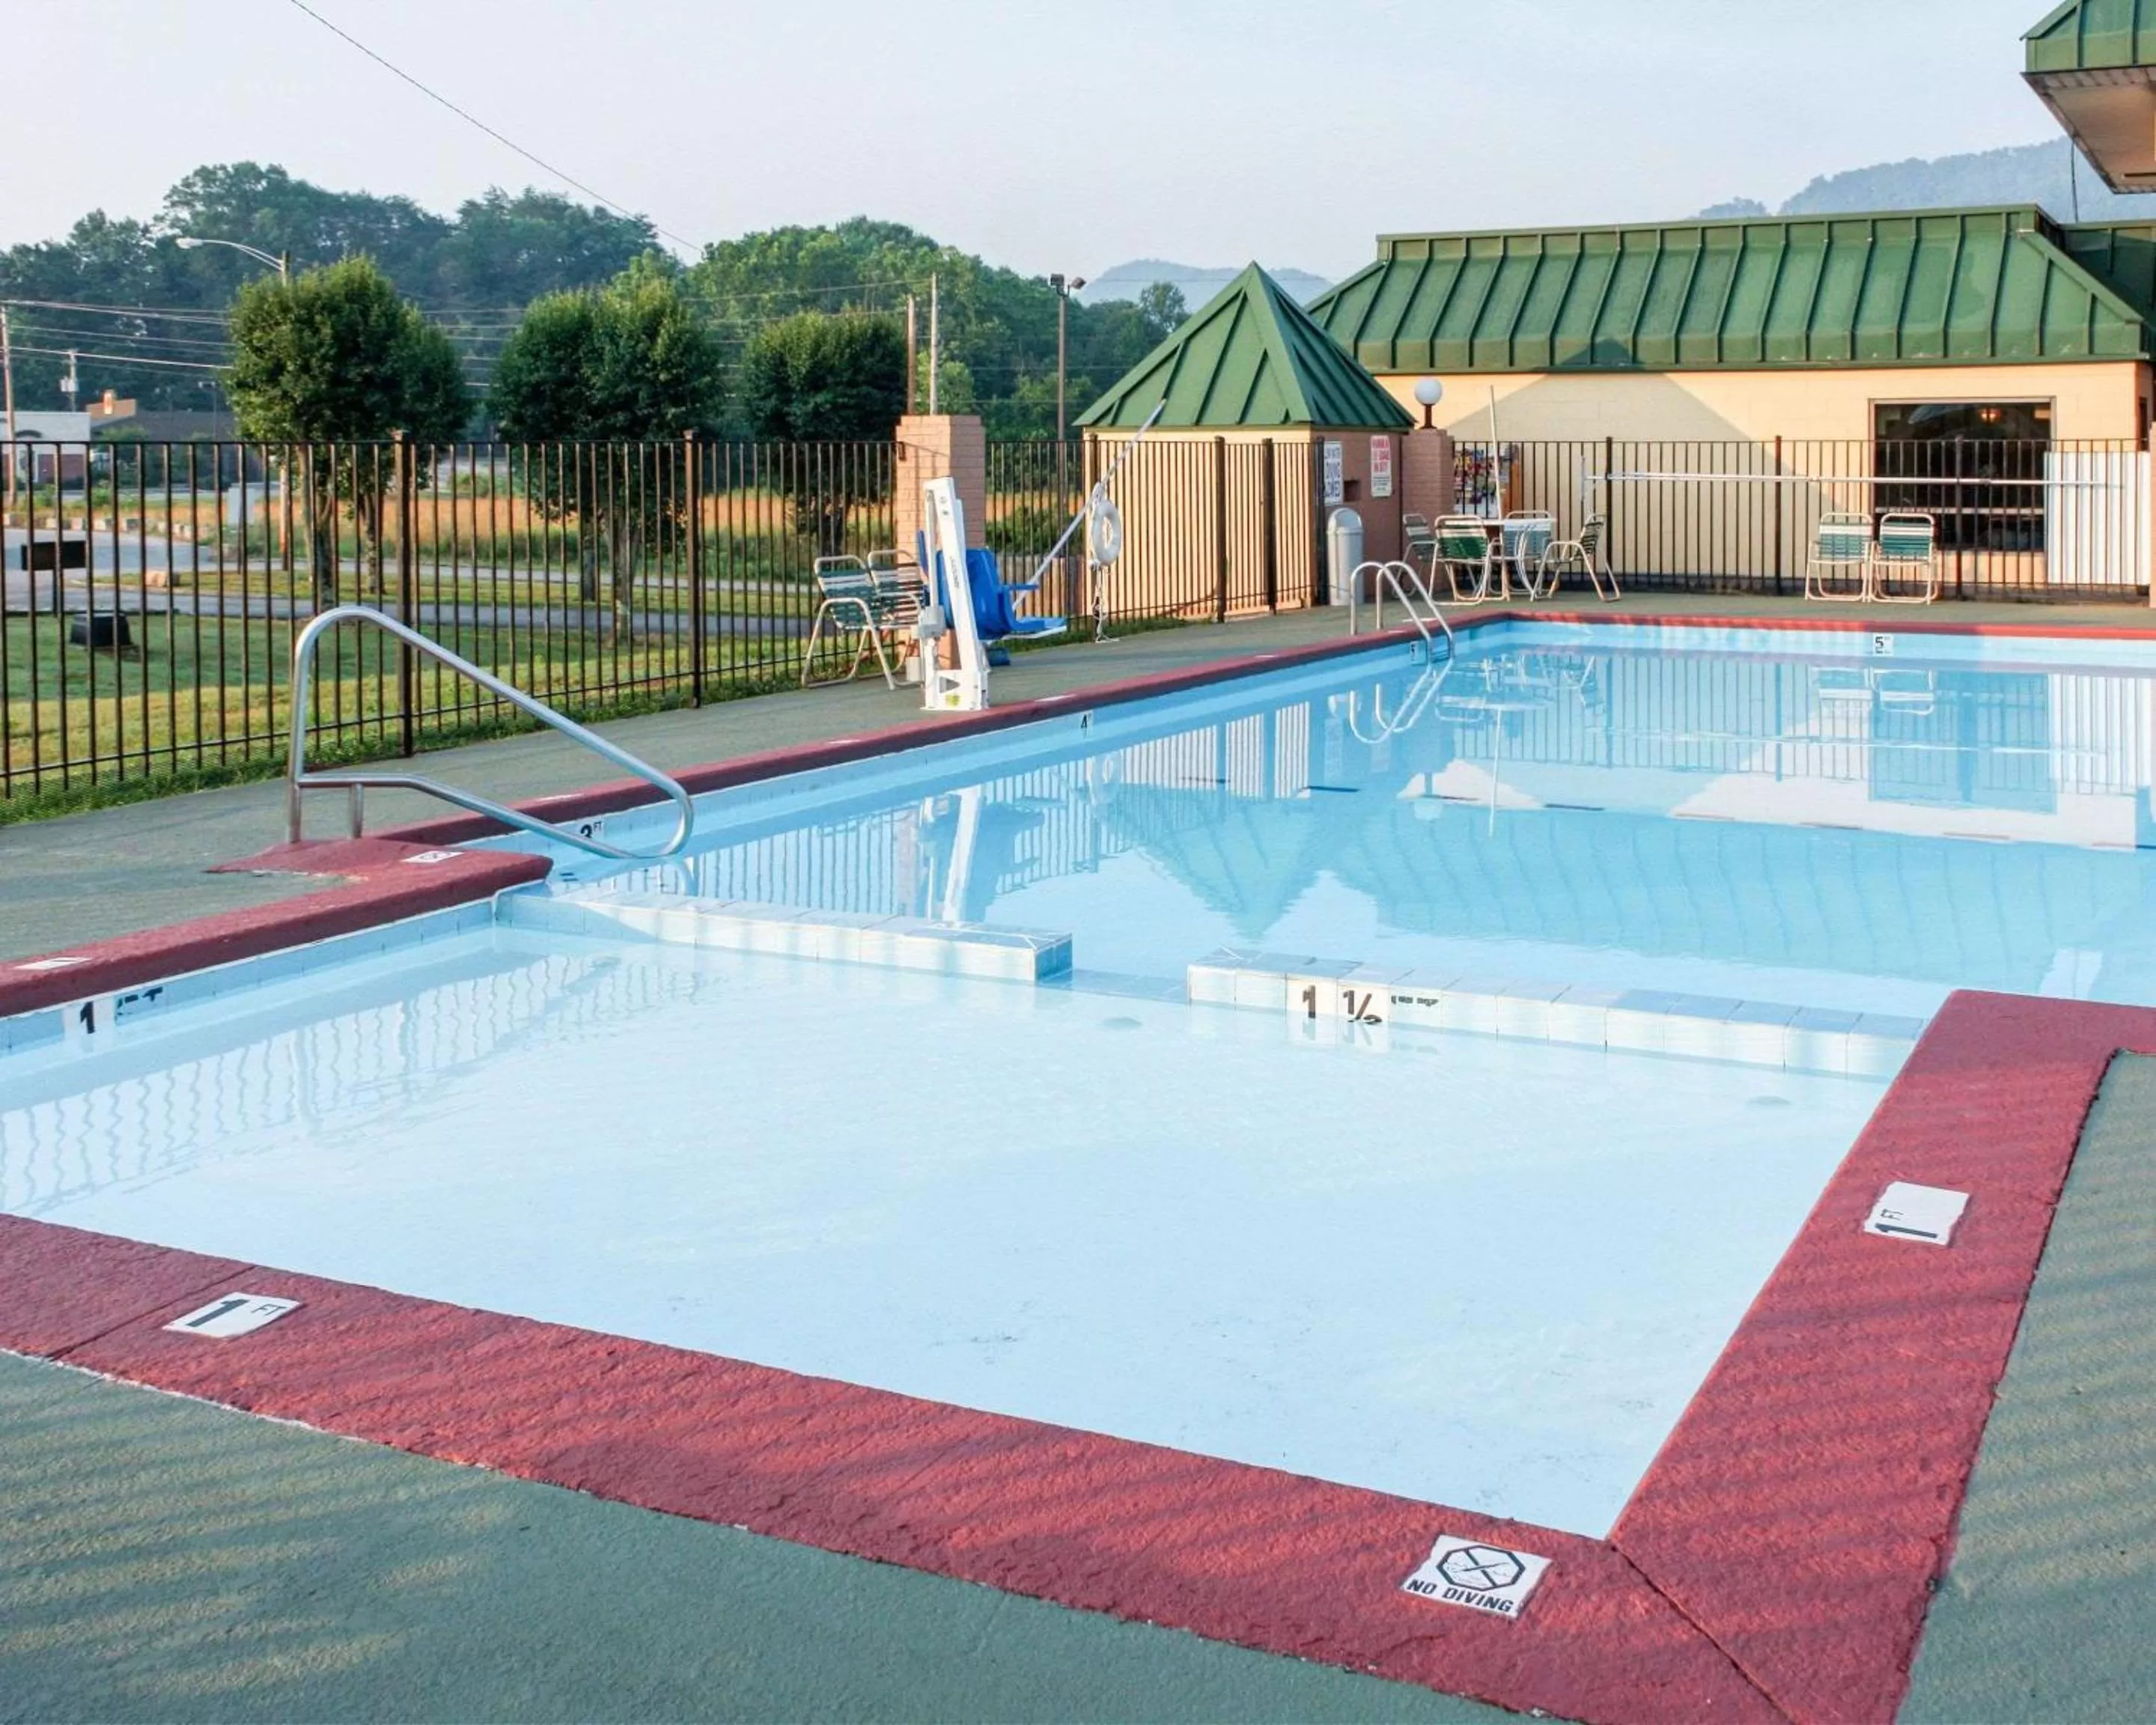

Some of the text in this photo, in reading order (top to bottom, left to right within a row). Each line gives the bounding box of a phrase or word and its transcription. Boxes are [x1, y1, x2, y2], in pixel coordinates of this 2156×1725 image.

[1875, 636, 1884, 648] 5
[80, 1000, 95, 1034] 1
[1302, 985, 1316, 1019] 1
[1875, 1208, 1937, 1238] 1 FT
[186, 1298, 287, 1327] 1 FT
[1407, 1578, 1514, 1613] NO DIVING
